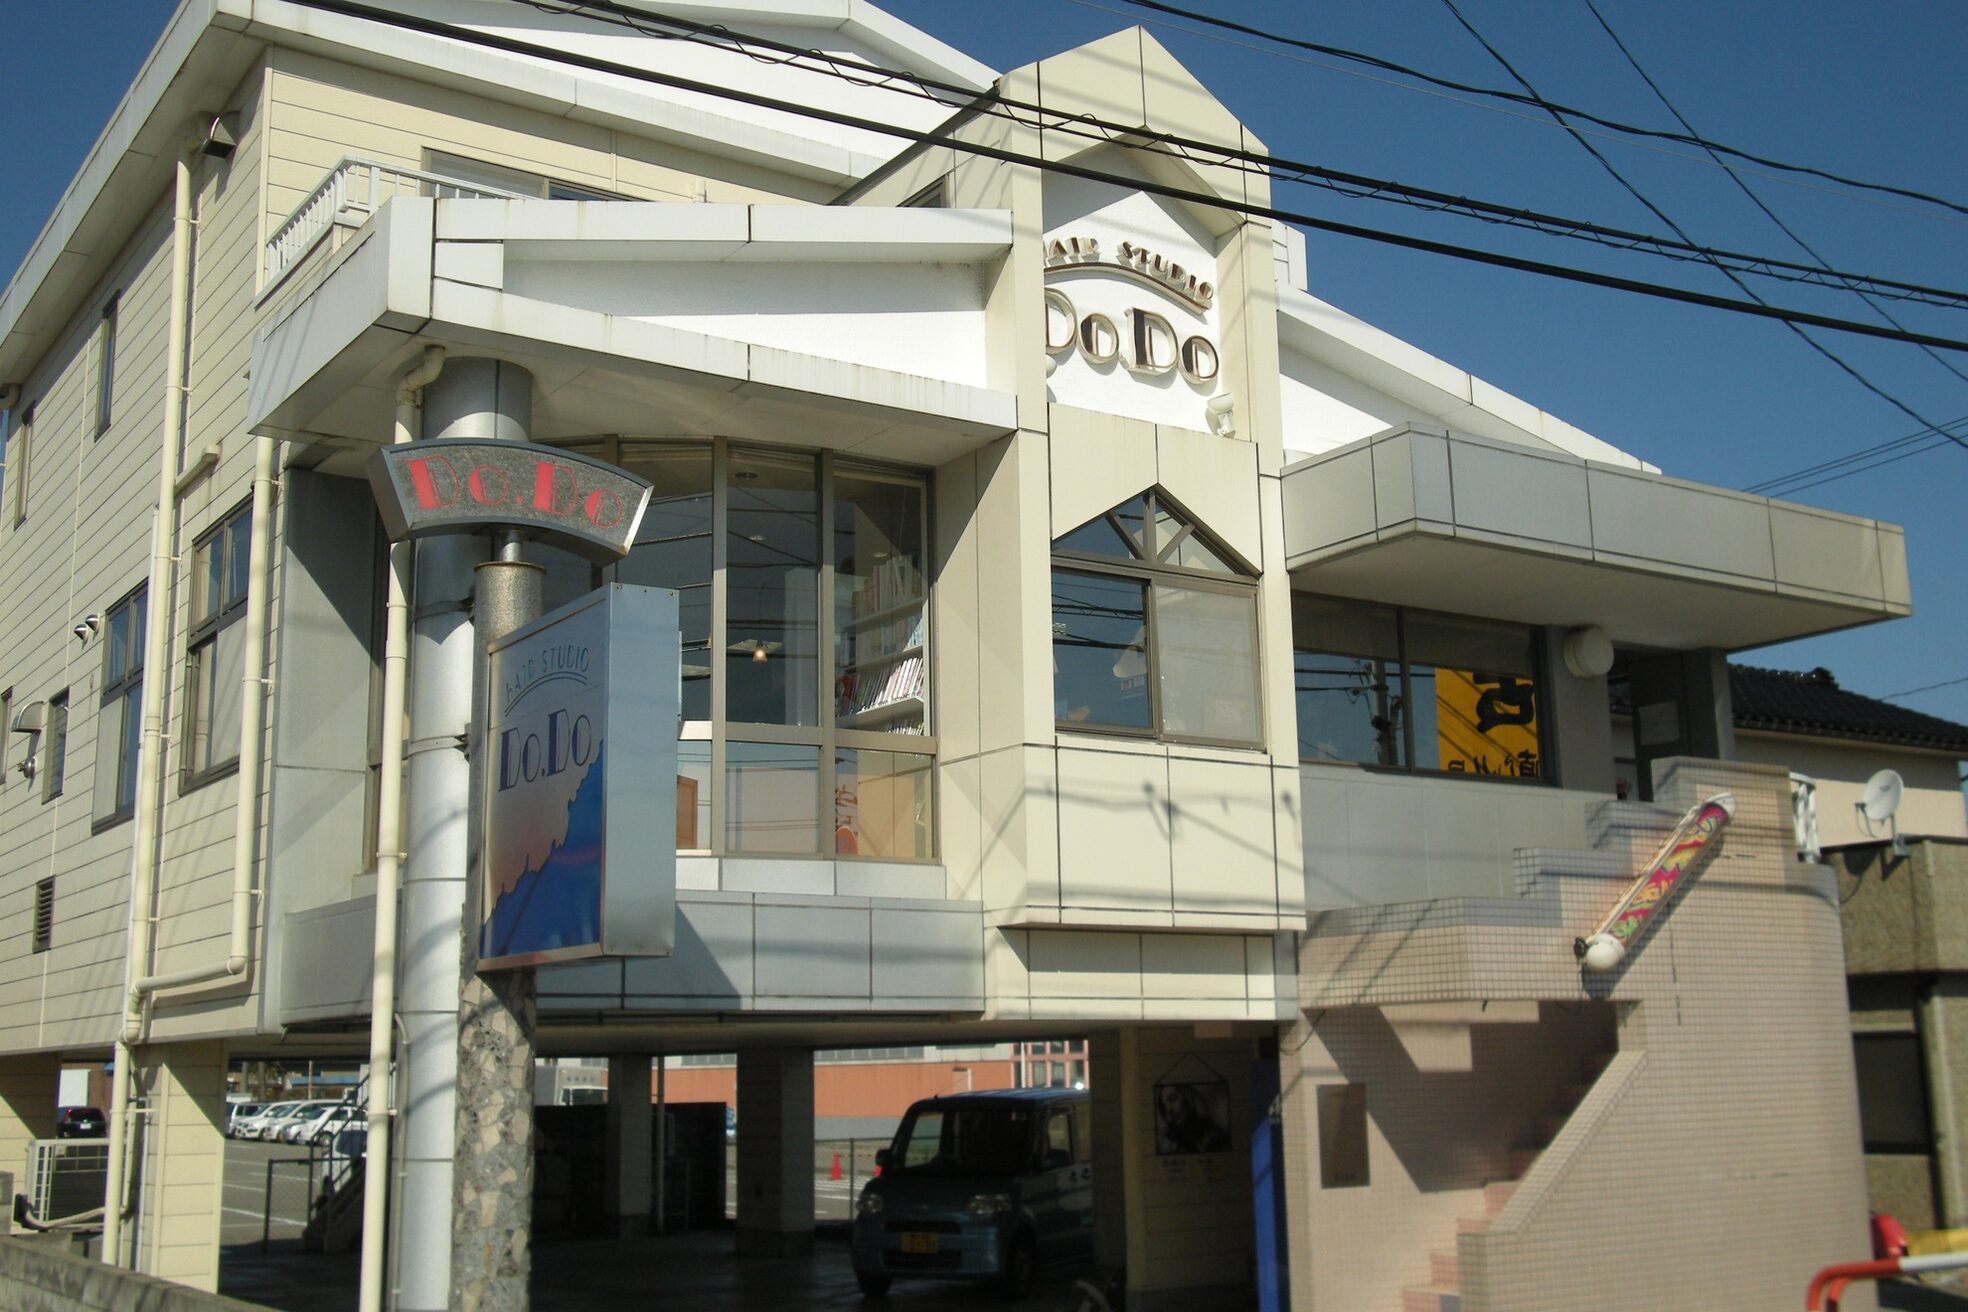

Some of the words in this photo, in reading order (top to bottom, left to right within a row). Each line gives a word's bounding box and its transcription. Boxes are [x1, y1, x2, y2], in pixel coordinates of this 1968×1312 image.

[1044, 237, 1099, 259] AIR
[1117, 241, 1214, 302] STUDIO
[541, 644, 590, 673] STUDIO
